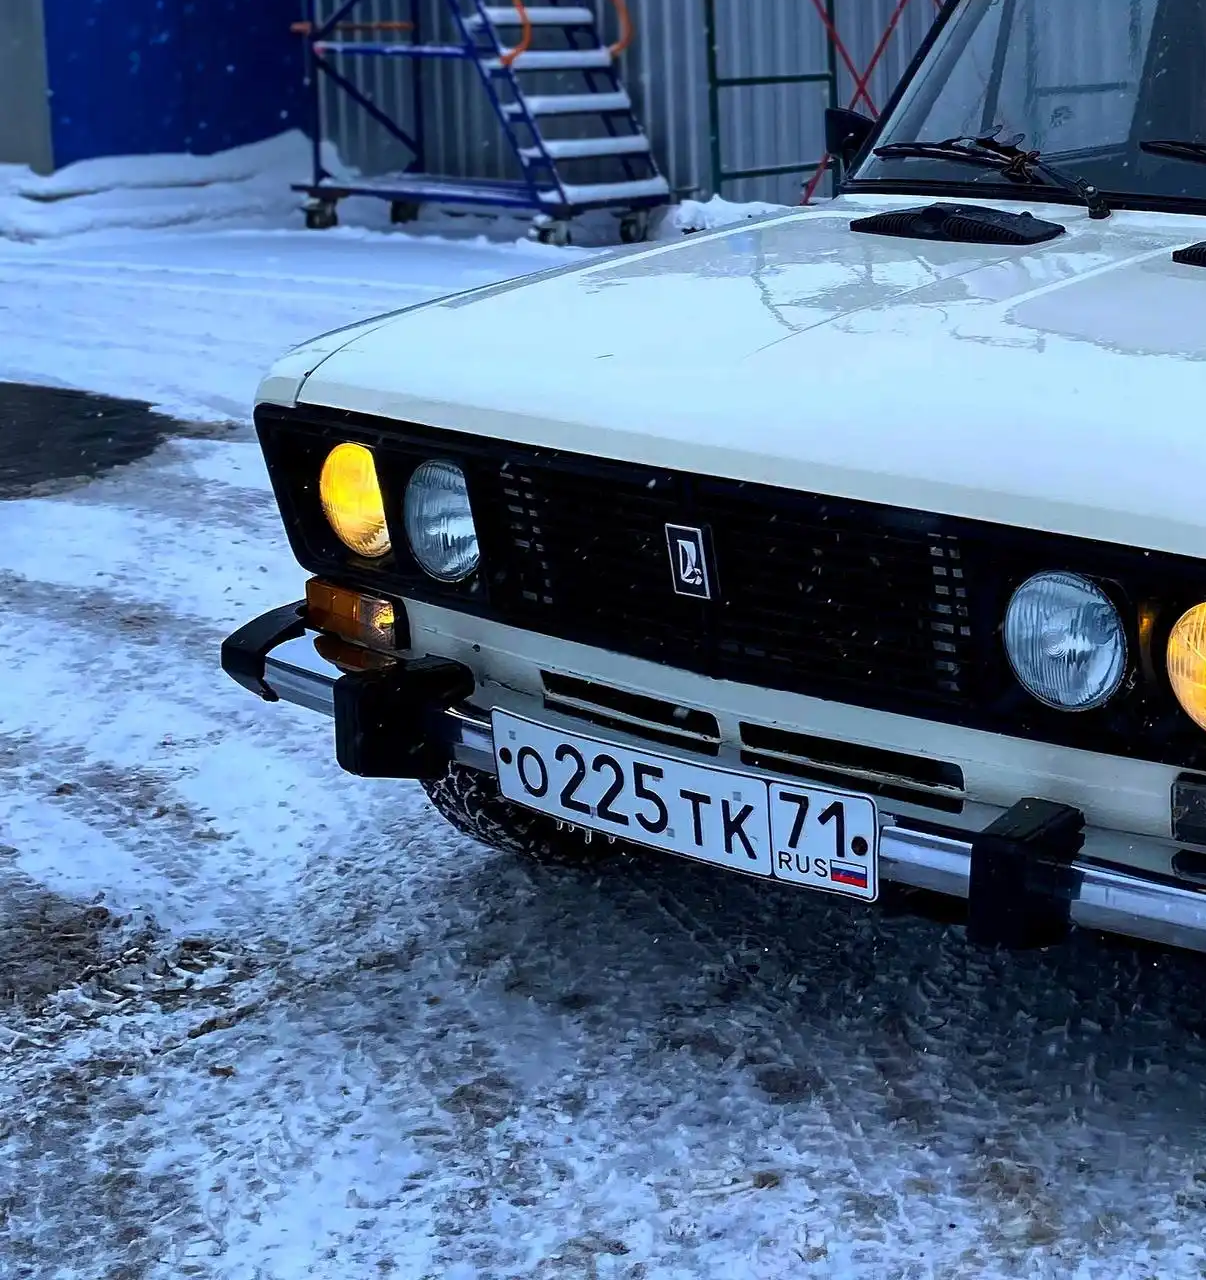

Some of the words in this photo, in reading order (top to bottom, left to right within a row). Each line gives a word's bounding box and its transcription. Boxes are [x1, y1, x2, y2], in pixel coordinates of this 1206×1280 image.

[516, 742, 758, 860] О225ТК
[779, 790, 846, 858] 71
[778, 850, 829, 878] RUS
